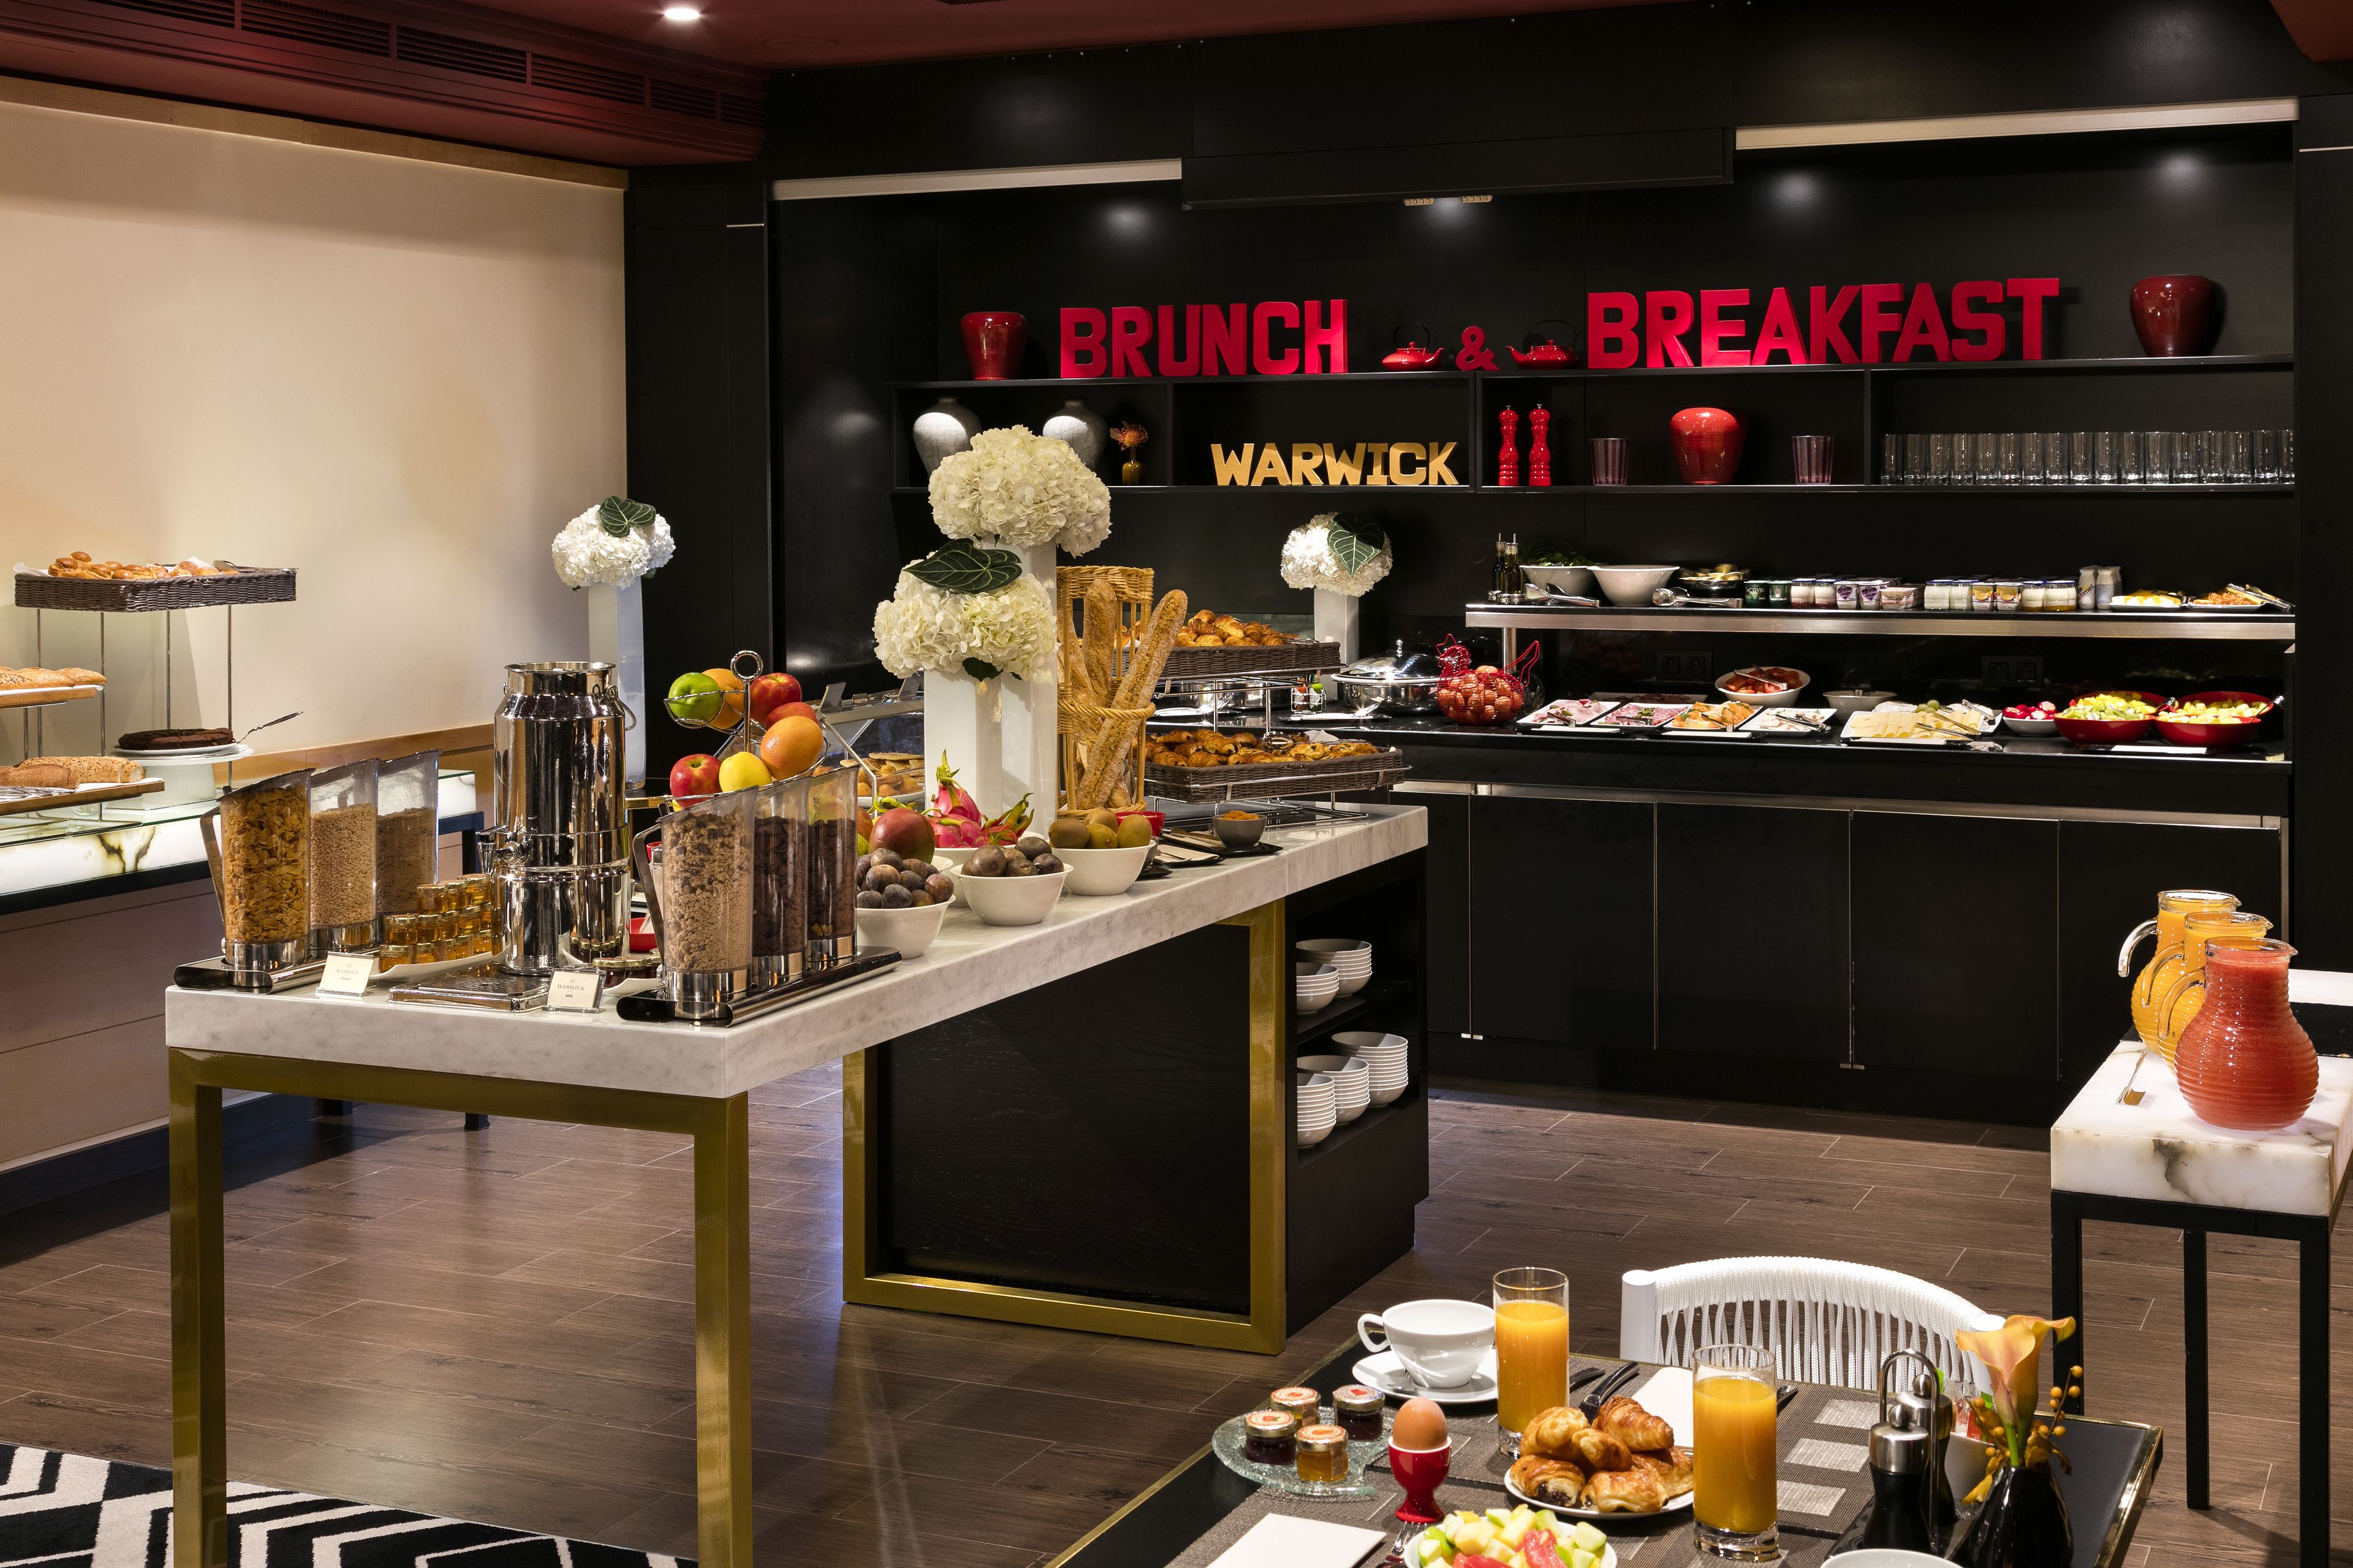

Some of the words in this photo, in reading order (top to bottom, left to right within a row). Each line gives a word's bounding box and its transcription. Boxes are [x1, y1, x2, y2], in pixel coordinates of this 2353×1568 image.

[1061, 299, 1348, 379] BRUNCH
[1456, 326, 1499, 371] &
[1588, 278, 2059, 369] BREAKFAST
[1211, 442, 1459, 486] WARWICK
